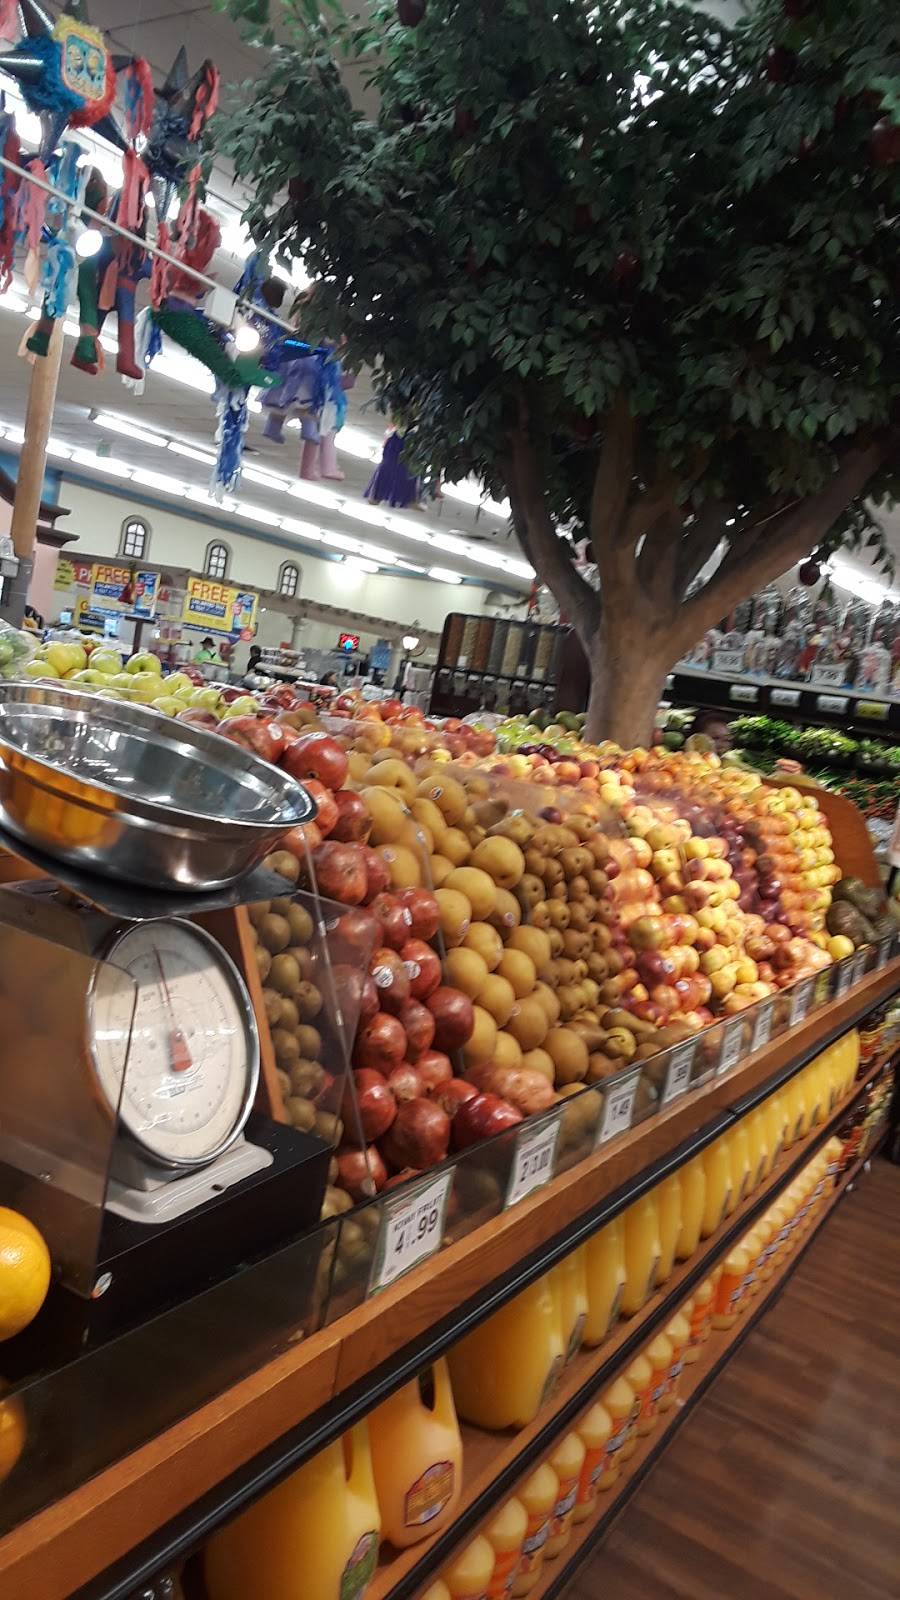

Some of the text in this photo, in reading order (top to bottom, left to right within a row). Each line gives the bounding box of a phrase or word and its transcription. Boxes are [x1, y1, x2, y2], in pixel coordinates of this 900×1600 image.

[96, 566, 131, 585] FREE
[190, 580, 230, 604] FREE
[417, 1193, 444, 1214] FRUIT
